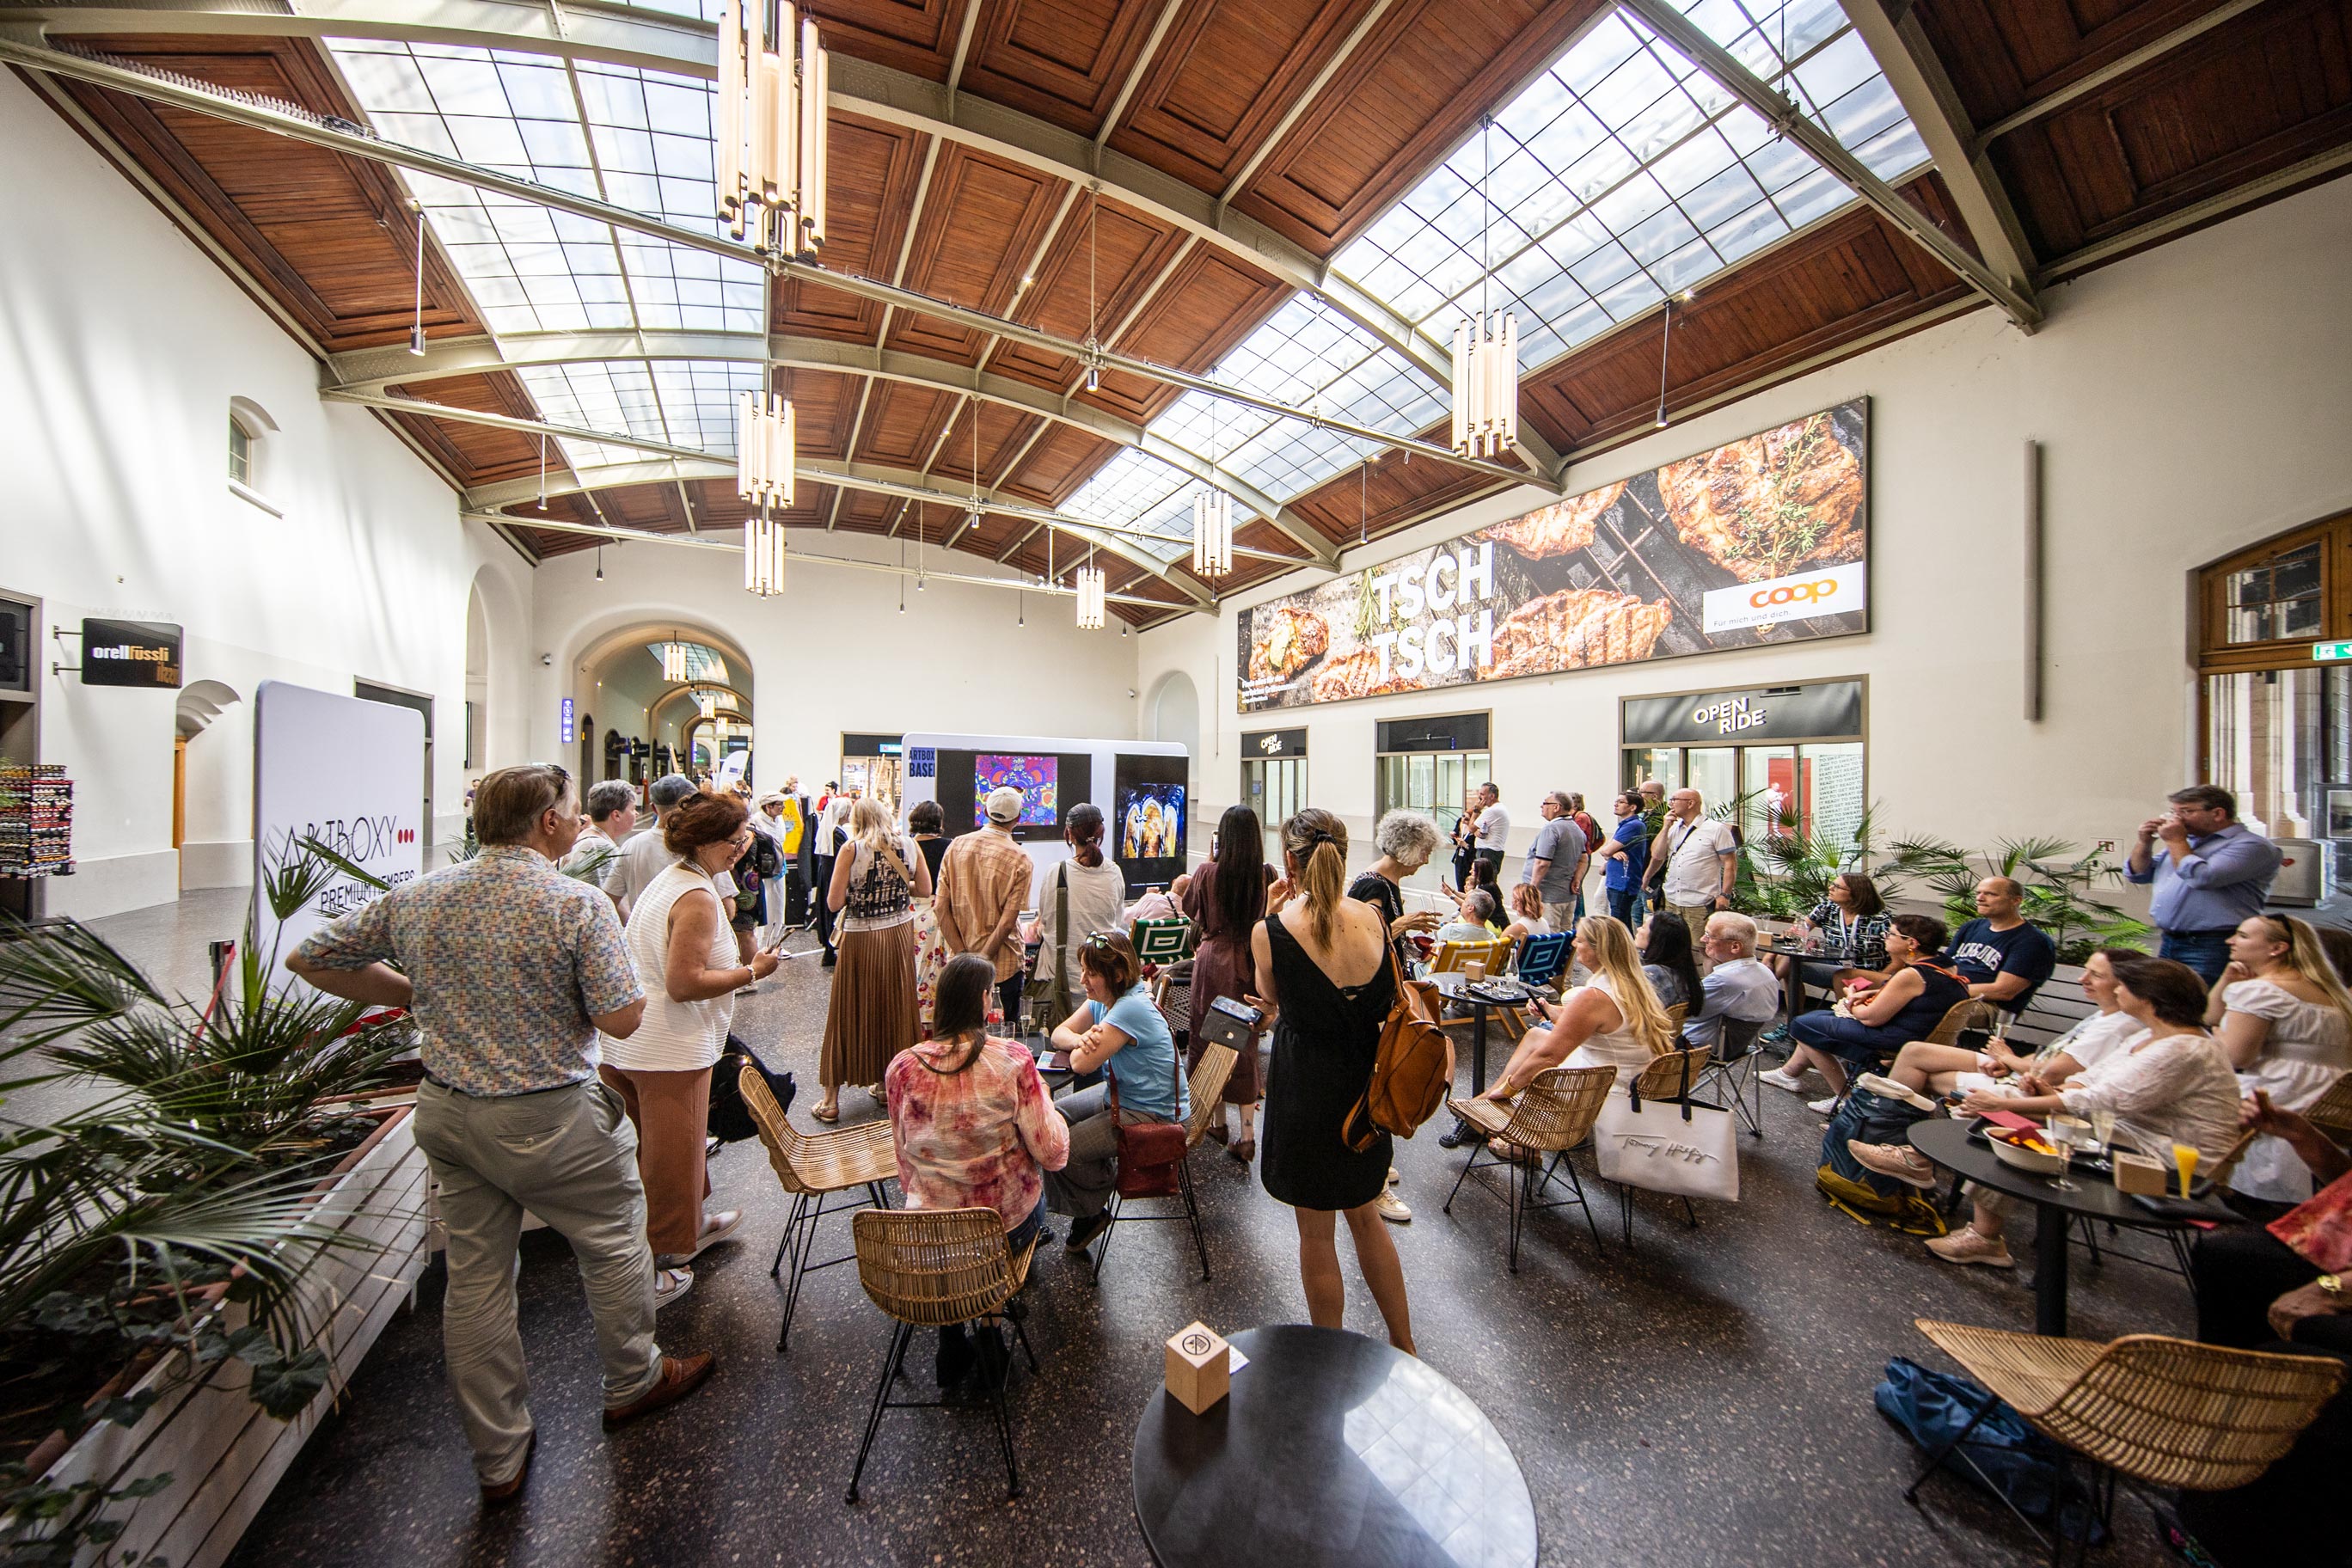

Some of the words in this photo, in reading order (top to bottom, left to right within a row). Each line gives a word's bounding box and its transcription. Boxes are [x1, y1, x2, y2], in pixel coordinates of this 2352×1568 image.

[1372, 541, 1493, 625] TSCH
[1749, 579, 1838, 608] coop
[1729, 616, 1749, 626] mich
[1372, 609, 1493, 682] TSCH
[1694, 697, 1749, 724] OPEN
[1719, 709, 1766, 734] RIDE
[909, 750, 934, 760] ARTBOX
[1261, 734, 1277, 749] OPEN
[1268, 740, 1282, 755] RIDE
[281, 816, 396, 875] ARTBOXY
[321, 879, 371, 914] PREMIUM
[373, 870, 415, 894] EMBERS
